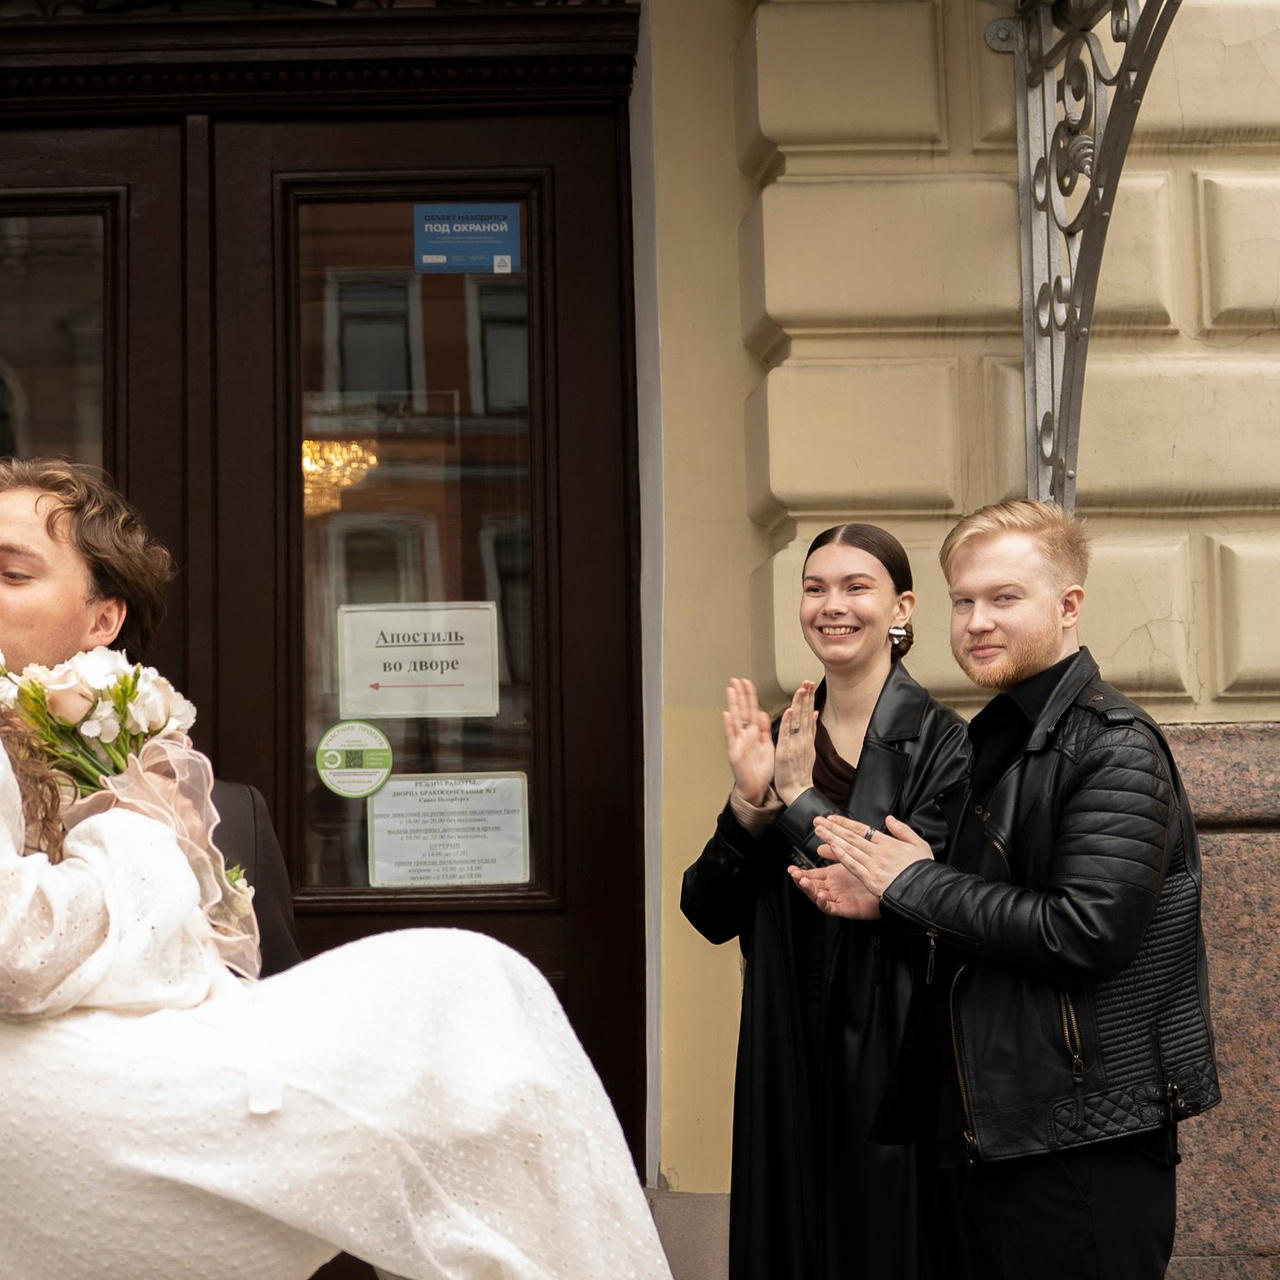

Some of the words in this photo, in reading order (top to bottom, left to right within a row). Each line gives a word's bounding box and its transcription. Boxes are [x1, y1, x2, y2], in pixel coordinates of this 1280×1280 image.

[458, 214, 508, 222] НАХОДИТСЯ
[424, 223, 451, 234] ПОД
[452, 221, 509, 233] ОХРАНОЙ
[375, 629, 465, 646] Апостиль
[382, 659, 403, 673] во
[408, 657, 461, 675] дворе
[324, 725, 355, 748] УЧАСТНИК
[358, 725, 386, 747] ПРОЕКТА
